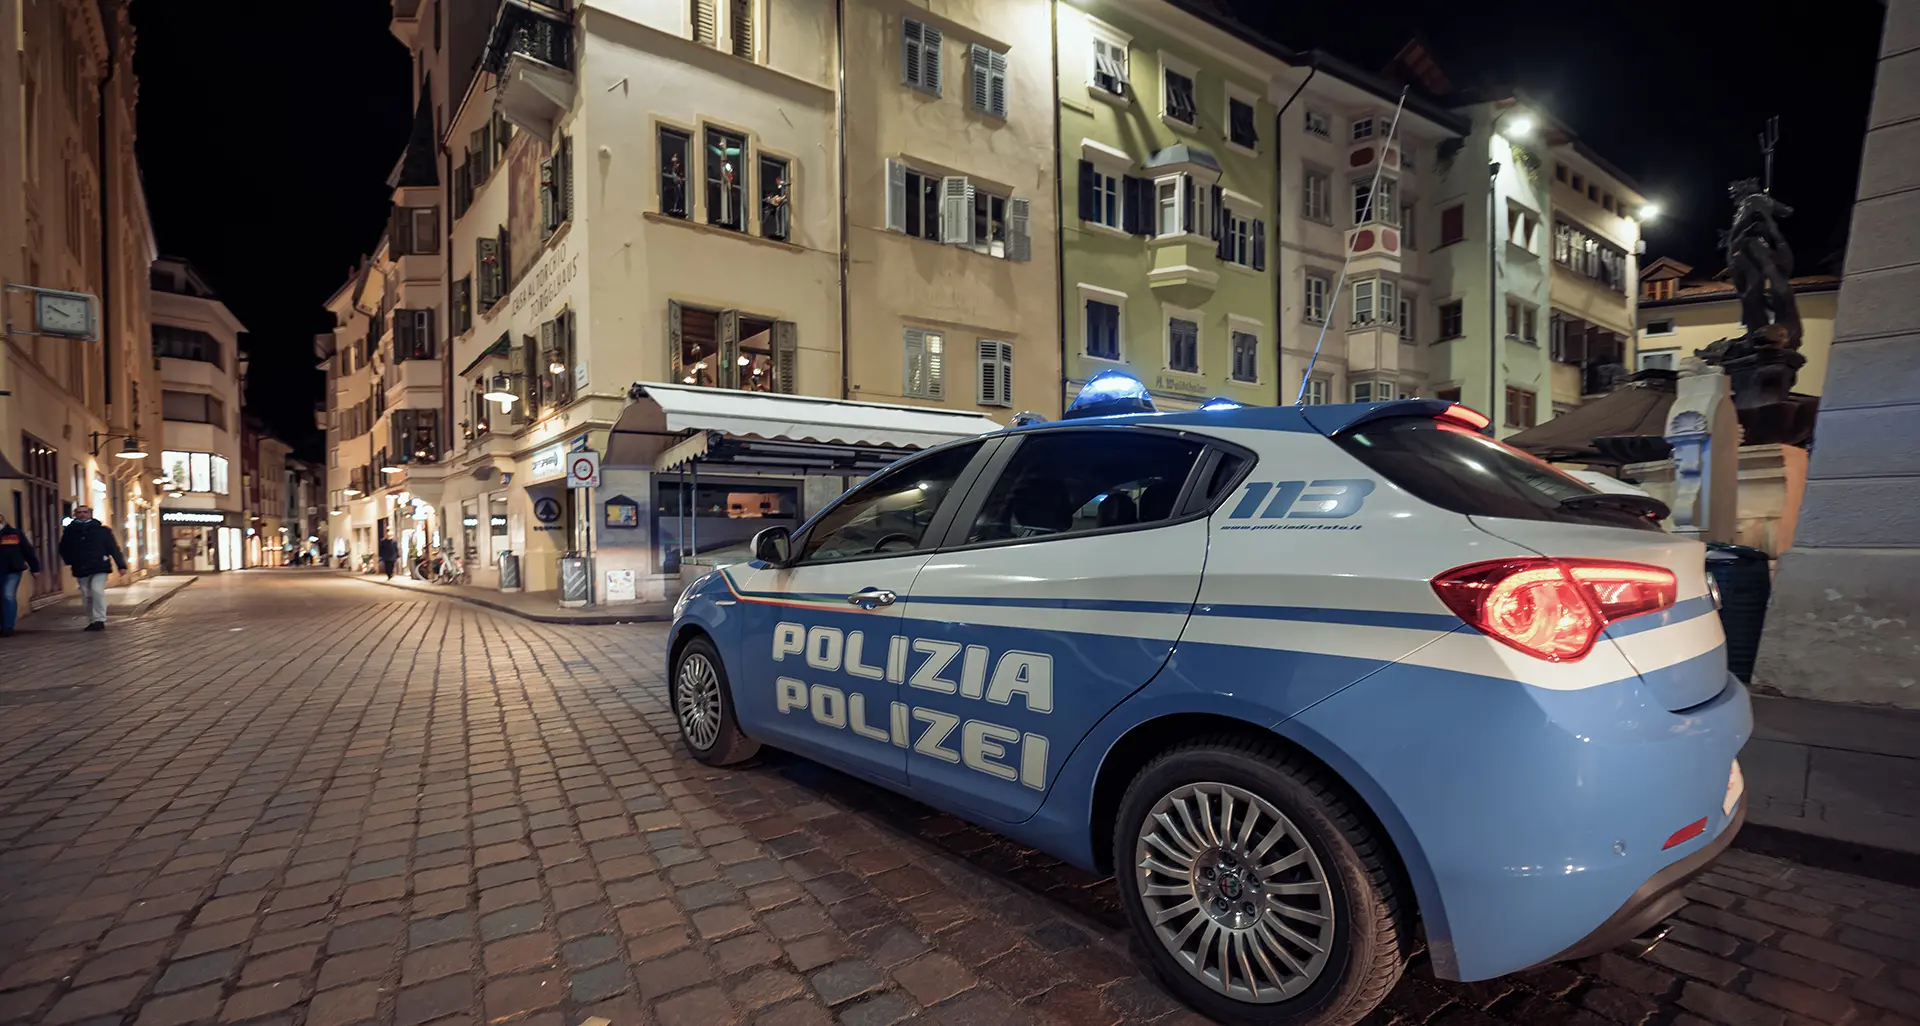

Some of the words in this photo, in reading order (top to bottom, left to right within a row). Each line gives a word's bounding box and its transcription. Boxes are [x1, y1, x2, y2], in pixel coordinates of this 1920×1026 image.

[1229, 478, 1376, 519] 113
[772, 621, 1054, 714] POLIZIA
[775, 675, 1050, 791] POLIZEI
